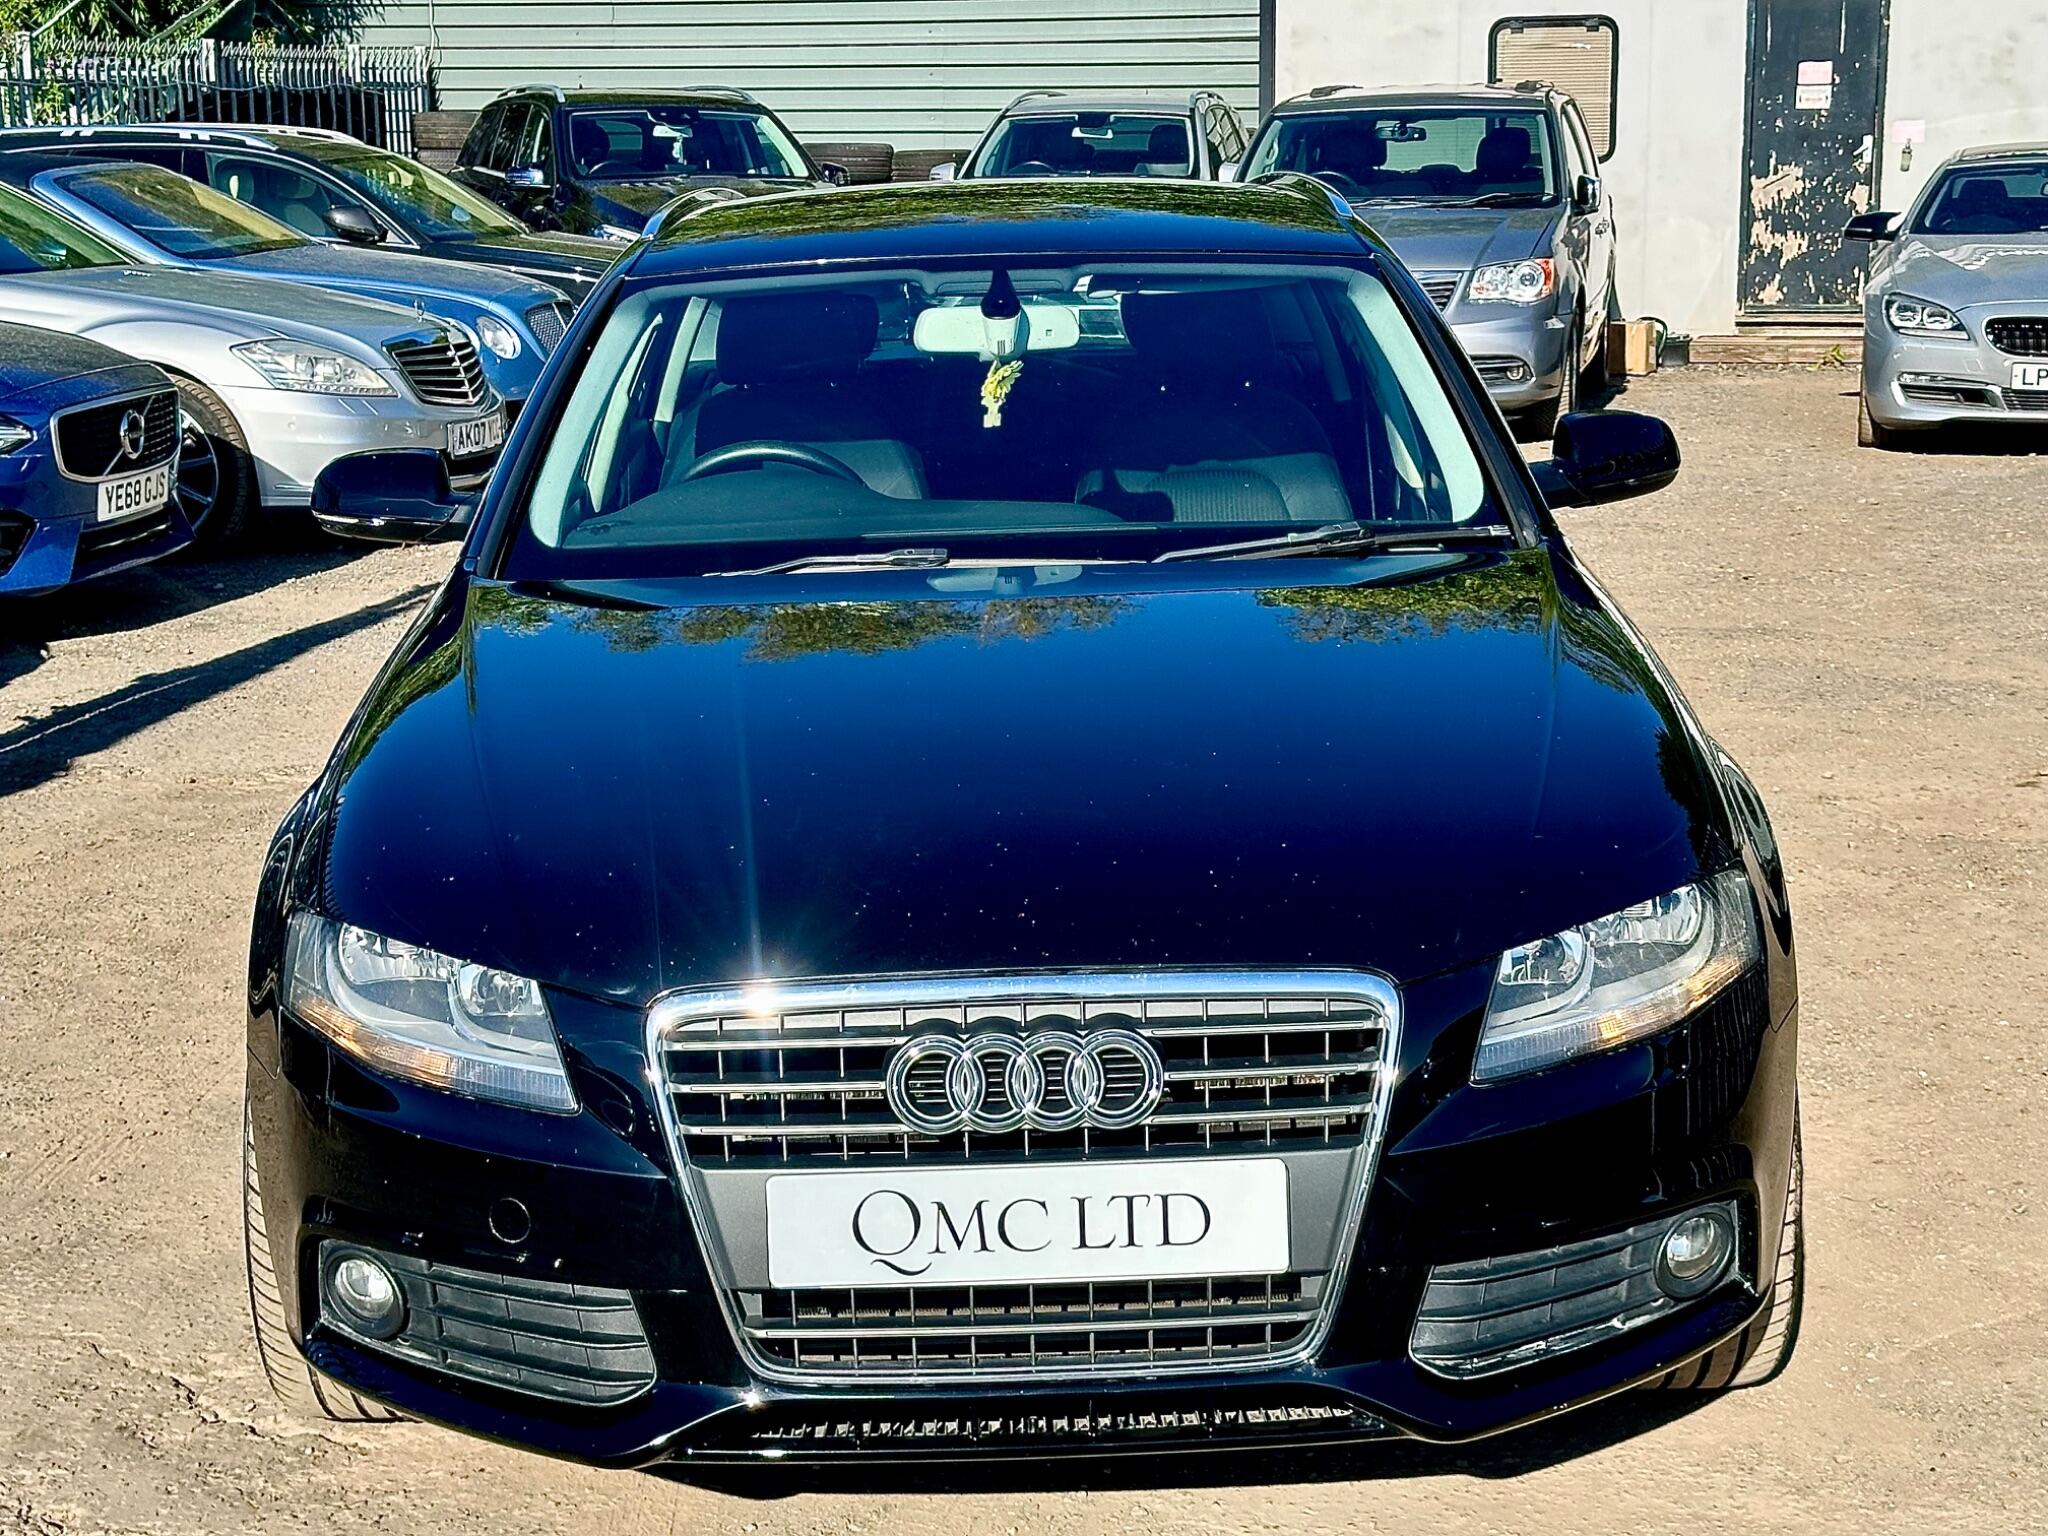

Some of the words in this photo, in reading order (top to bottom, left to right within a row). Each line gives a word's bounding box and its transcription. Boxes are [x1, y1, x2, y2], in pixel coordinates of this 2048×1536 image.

[458, 422, 486, 449] AK07
[105, 479, 142, 514] YE68
[144, 471, 166, 503] GJS
[852, 1189, 1052, 1276] QMC
[1070, 1193, 1211, 1250] LTD
